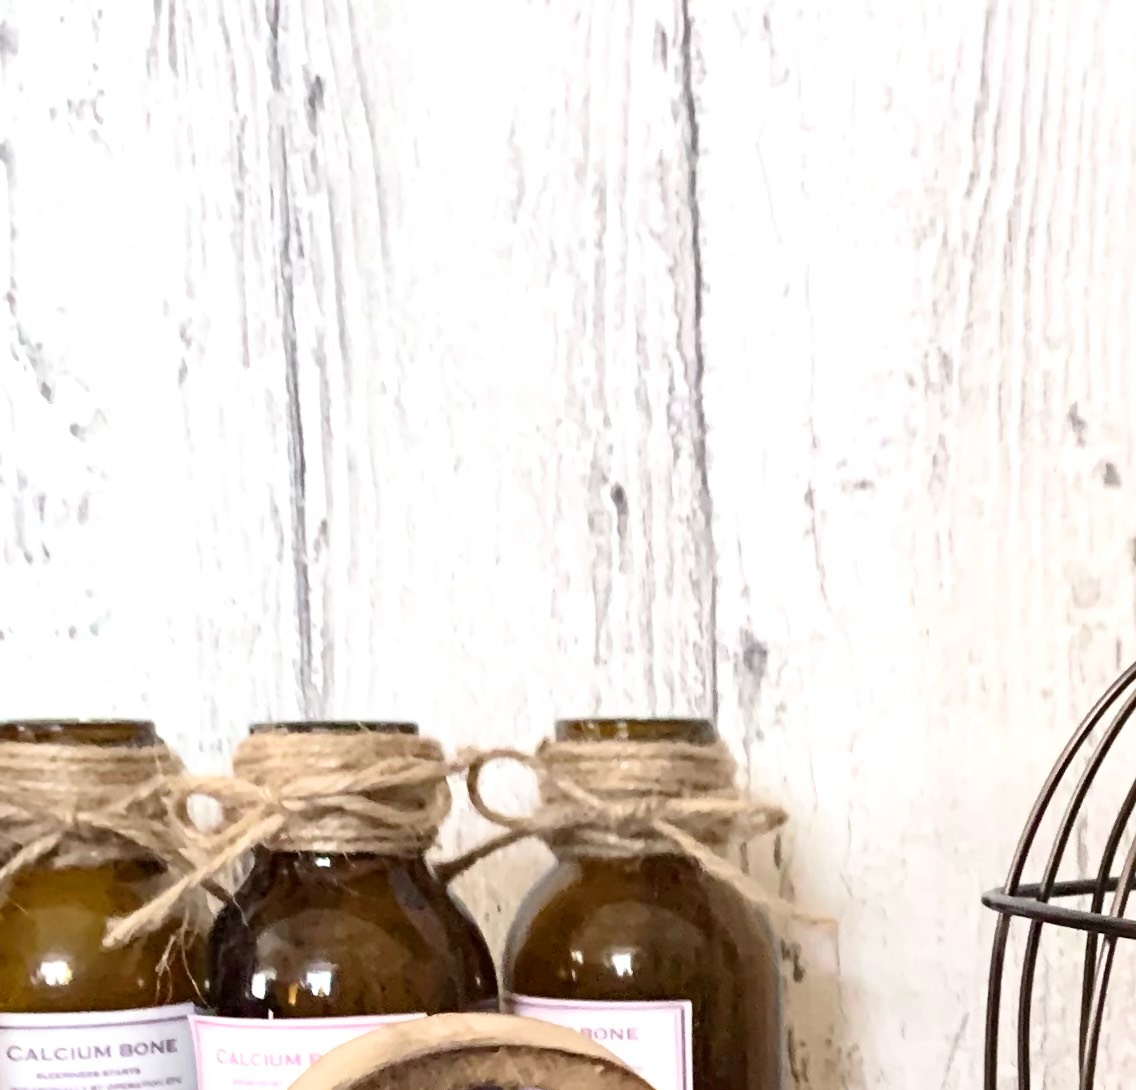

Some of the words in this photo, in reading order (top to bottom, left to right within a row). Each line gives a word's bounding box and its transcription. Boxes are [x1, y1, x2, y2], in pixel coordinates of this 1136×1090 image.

[6, 1045, 112, 1062] CALCIUM
[119, 1038, 178, 1058] BONE
[216, 1049, 301, 1067] CALCIUM
